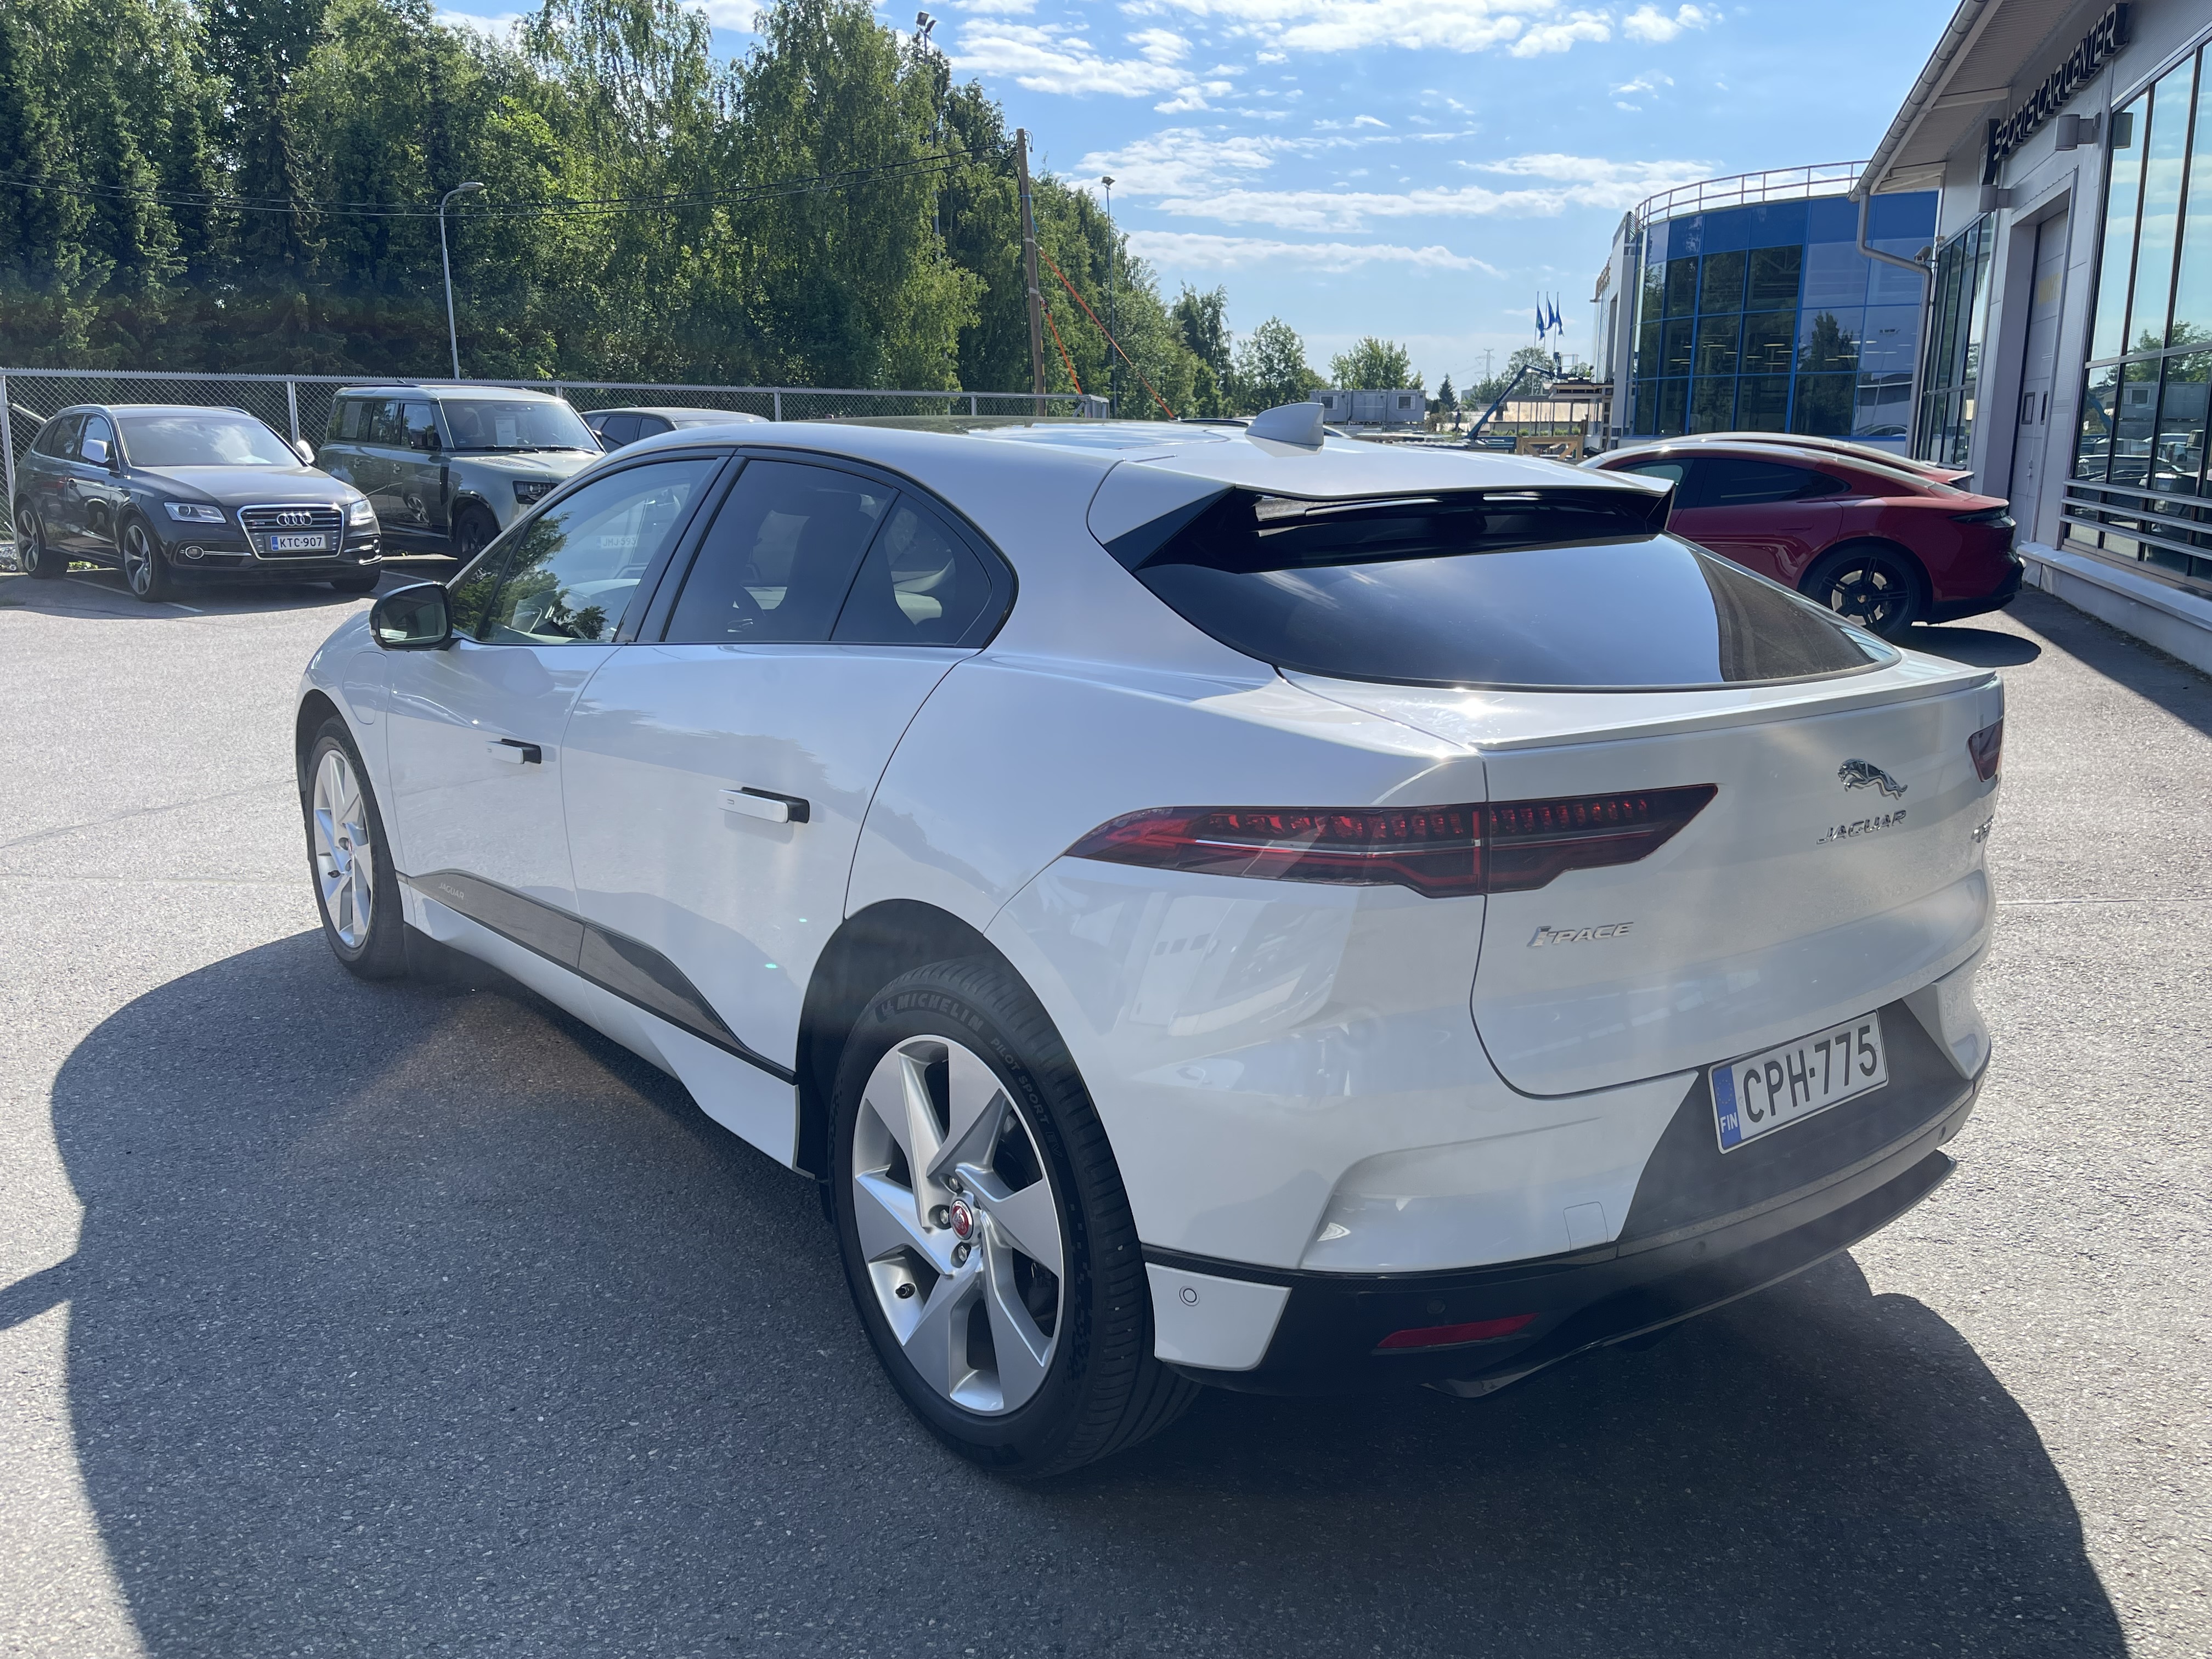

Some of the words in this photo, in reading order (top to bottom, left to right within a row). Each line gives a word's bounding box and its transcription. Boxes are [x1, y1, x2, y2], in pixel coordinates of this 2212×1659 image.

[1993, 93, 2034, 161] SPORTS
[2037, 64, 2063, 120] CAR
[2064, 3, 2117, 93] CENTER
[280, 537, 322, 548] KTC-907
[603, 537, 636, 546] JMJ-593
[1816, 810, 1906, 844] JAGUAR
[438, 882, 464, 900] JAGUAR
[896, 993, 984, 1032] MICHELIN
[991, 1037, 1020, 1071] PILOT
[1019, 1075, 1049, 1124] SPORT
[1045, 1131, 1063, 1158] EV
[1743, 1025, 1877, 1122] CPH-775
[1719, 1112, 1738, 1133] FIN
